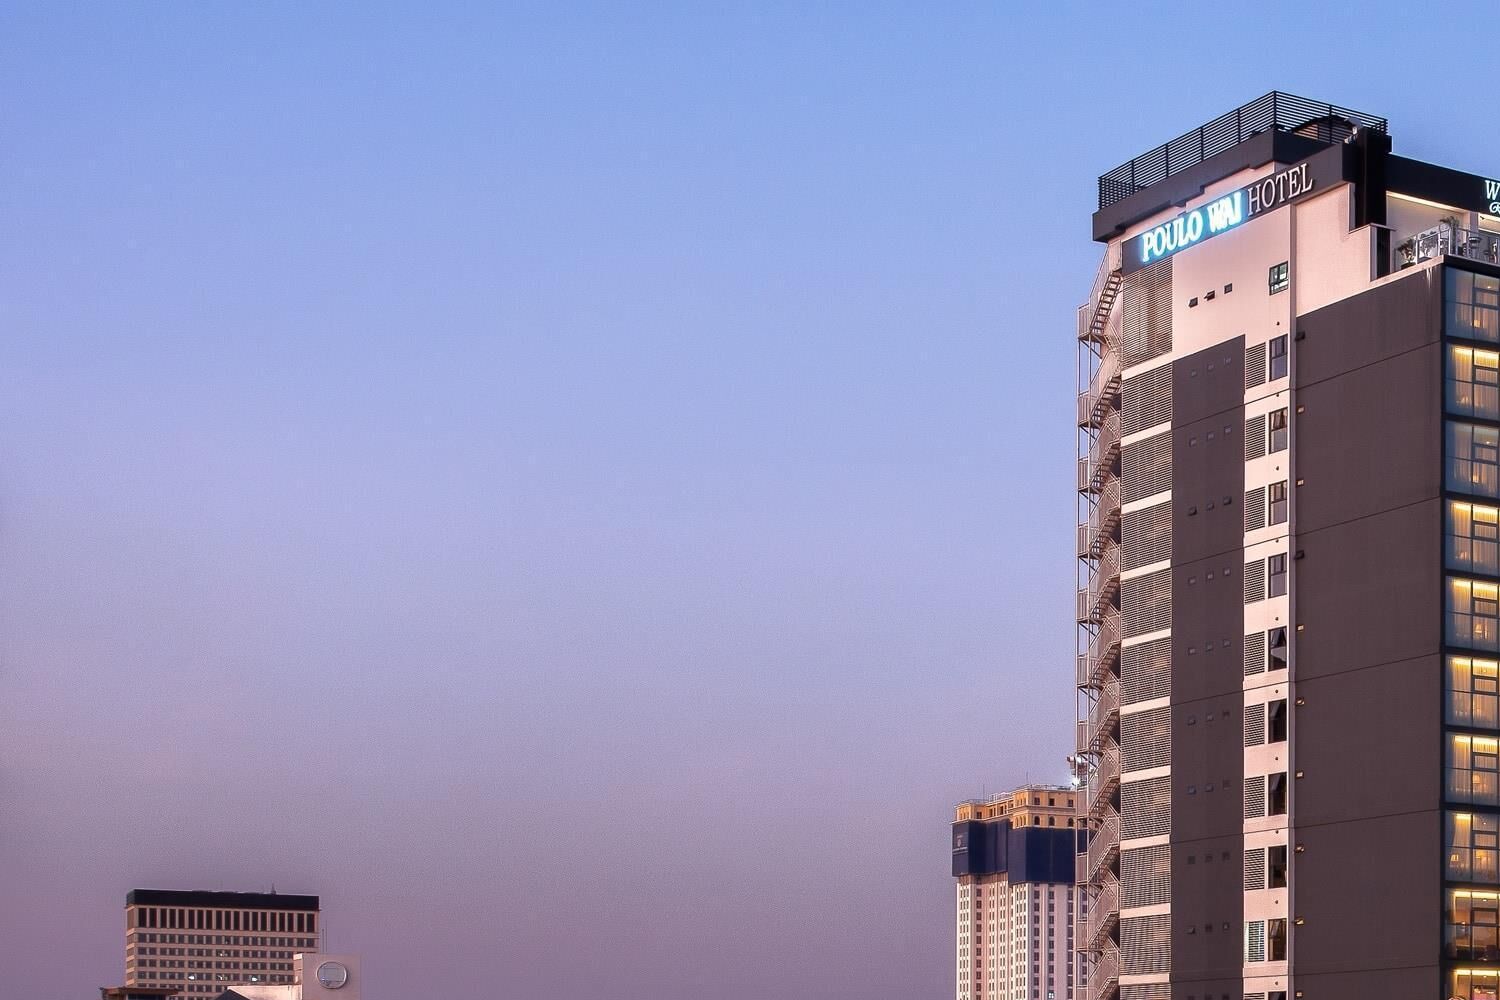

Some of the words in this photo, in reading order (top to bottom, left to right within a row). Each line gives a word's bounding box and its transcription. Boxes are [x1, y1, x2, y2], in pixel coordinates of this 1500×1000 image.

[1141, 211, 1204, 262] POULO
[1207, 191, 1243, 232] WAI
[1248, 163, 1313, 216] HOTEL
